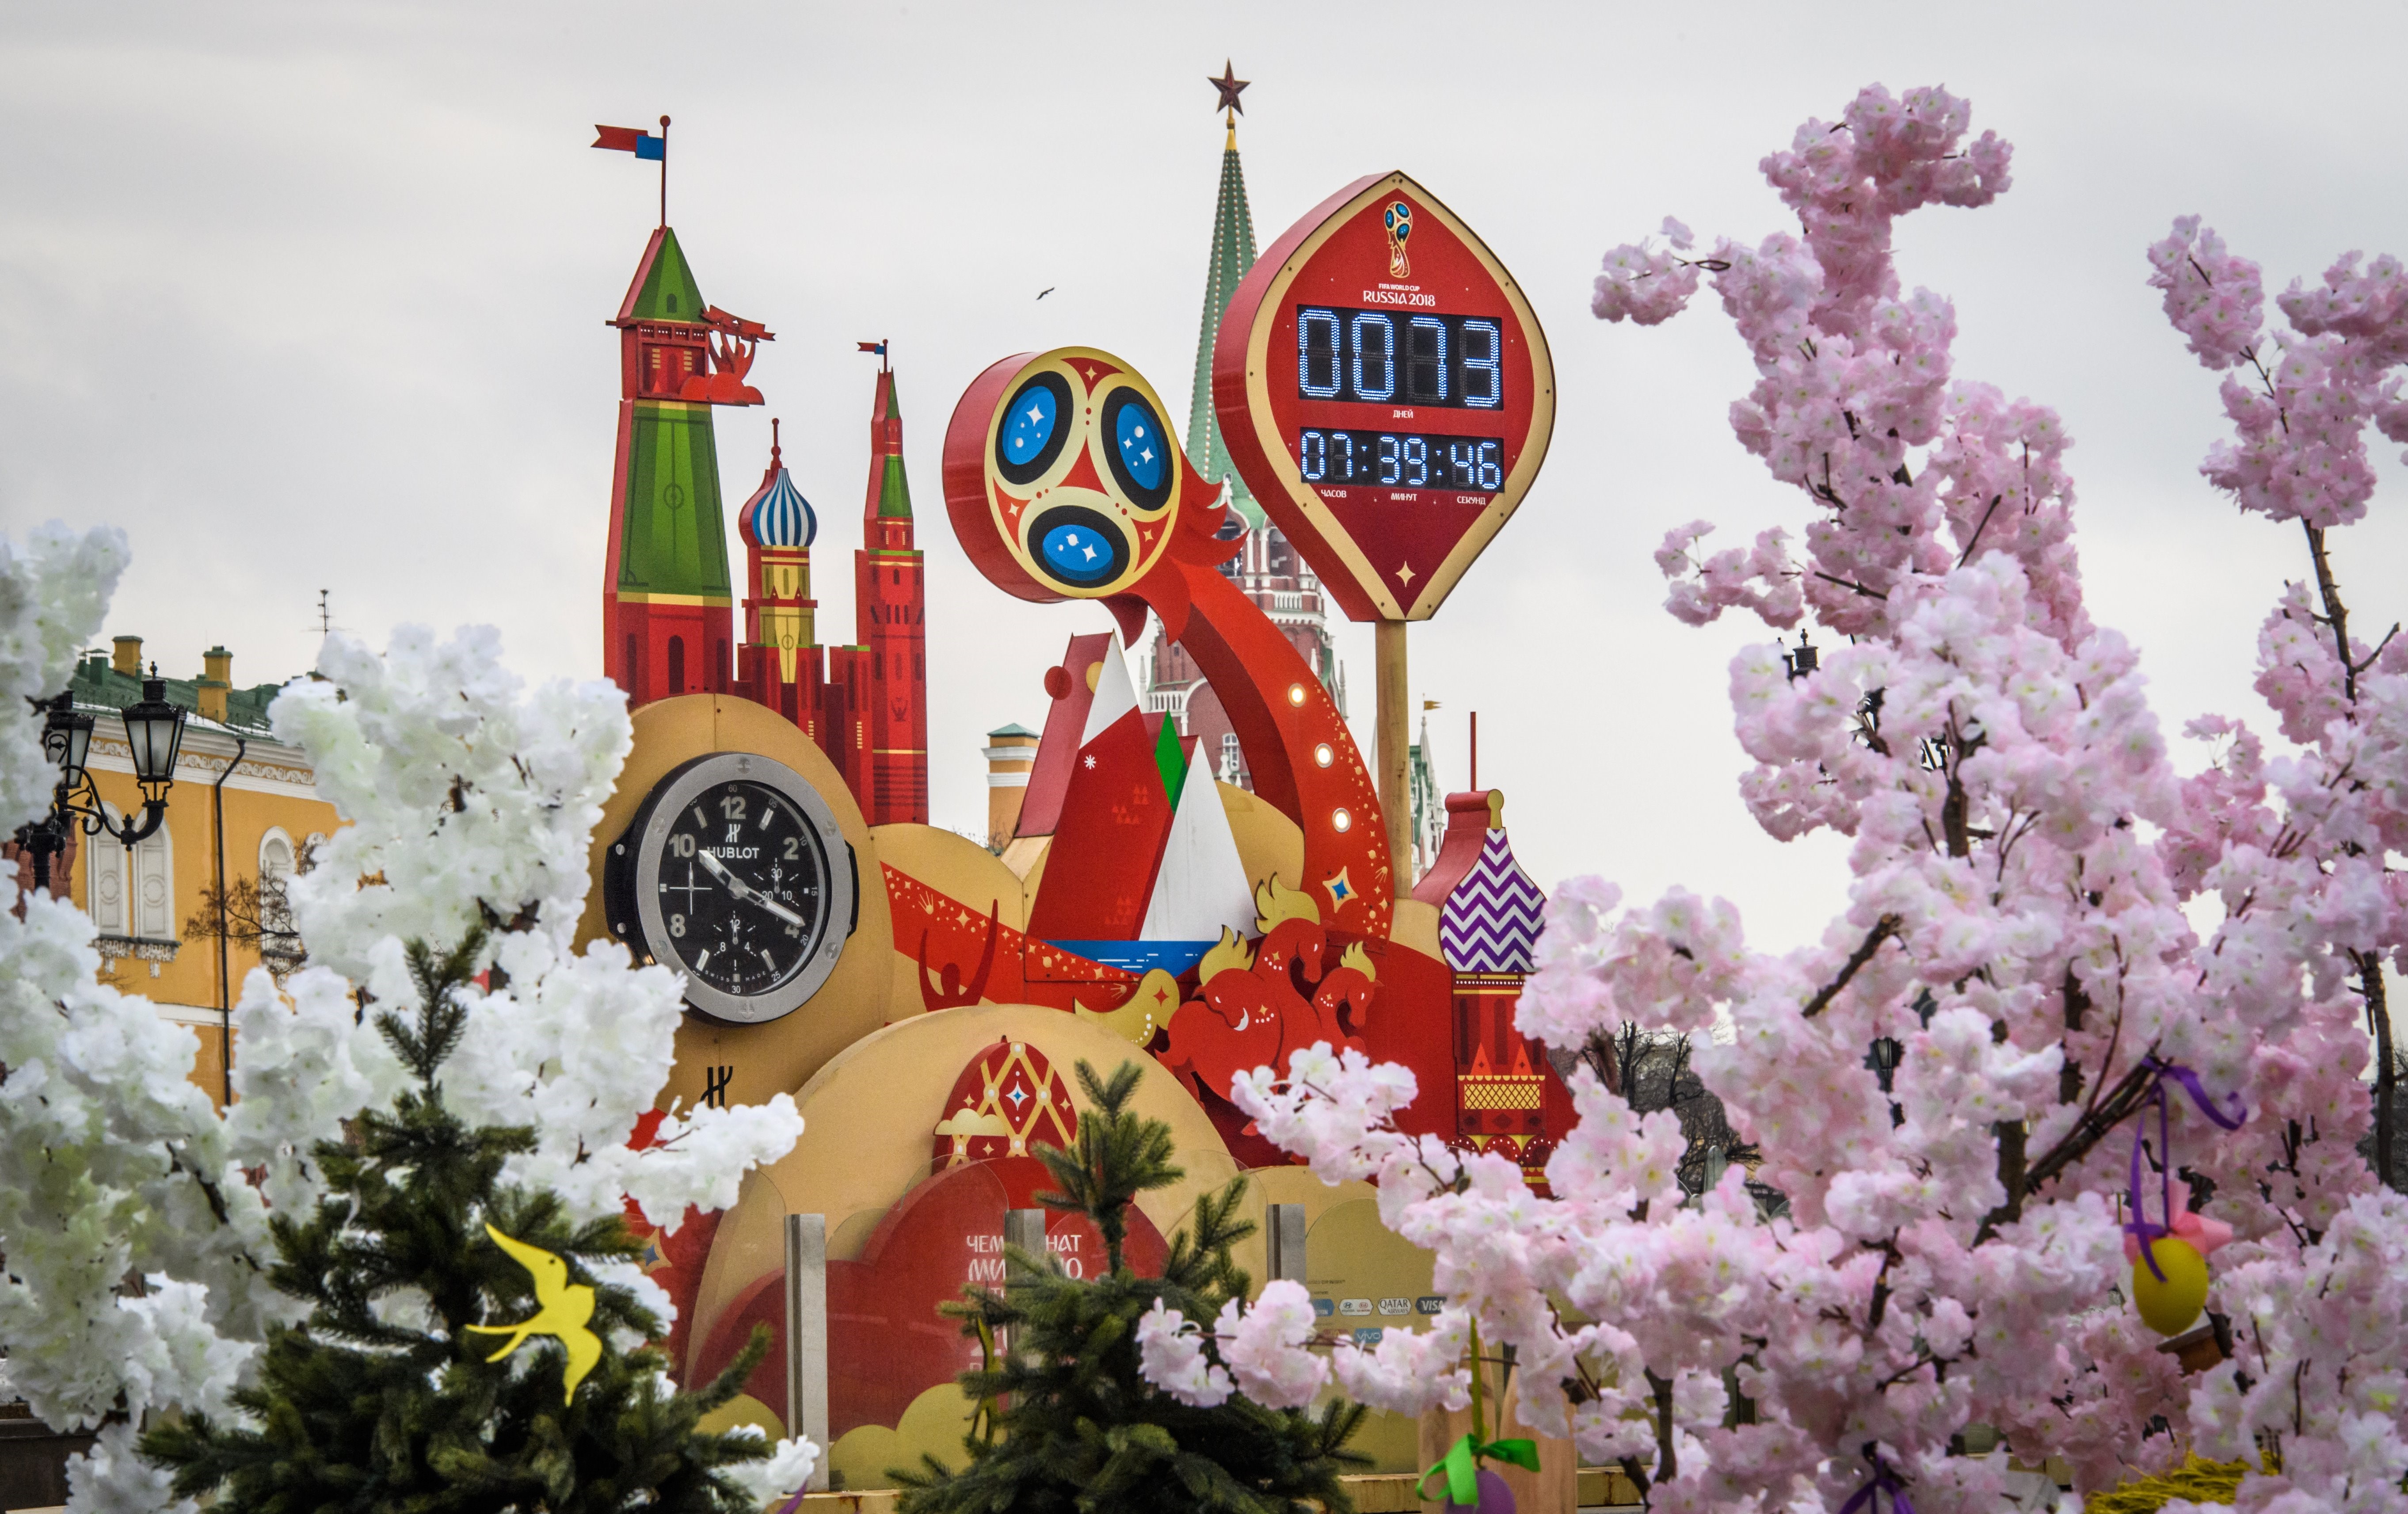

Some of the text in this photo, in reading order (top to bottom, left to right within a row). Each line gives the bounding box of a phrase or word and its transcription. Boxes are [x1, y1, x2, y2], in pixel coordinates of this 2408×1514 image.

[1363, 290, 1436, 306] RUSSIA 2018
[1299, 309, 1500, 407] 0073
[1393, 409, 1414, 419] ДНЕЙ
[1321, 489, 1347, 498] ЧАСОВ
[1391, 493, 1417, 501] МИНУТ
[1457, 496, 1486, 506] СЕКУНД
[720, 796, 746, 820] 12
[669, 834, 696, 858] 10
[783, 837, 799, 860] 2
[707, 847, 759, 859] HUBLOT
[771, 868, 782, 878] 30
[762, 891, 773, 901] 20
[782, 891, 792, 900] 10
[670, 914, 686, 938] 8
[800, 934, 809, 947] 20
[720, 942, 726, 952] 8
[744, 942, 750, 951] 4
[705, 970, 730, 982] SWISS
[745, 971, 766, 981] MADE
[771, 972, 781, 981] 25
[1380, 1299, 1409, 1309] QATAR
[1357, 1331, 1380, 1340] vivo
